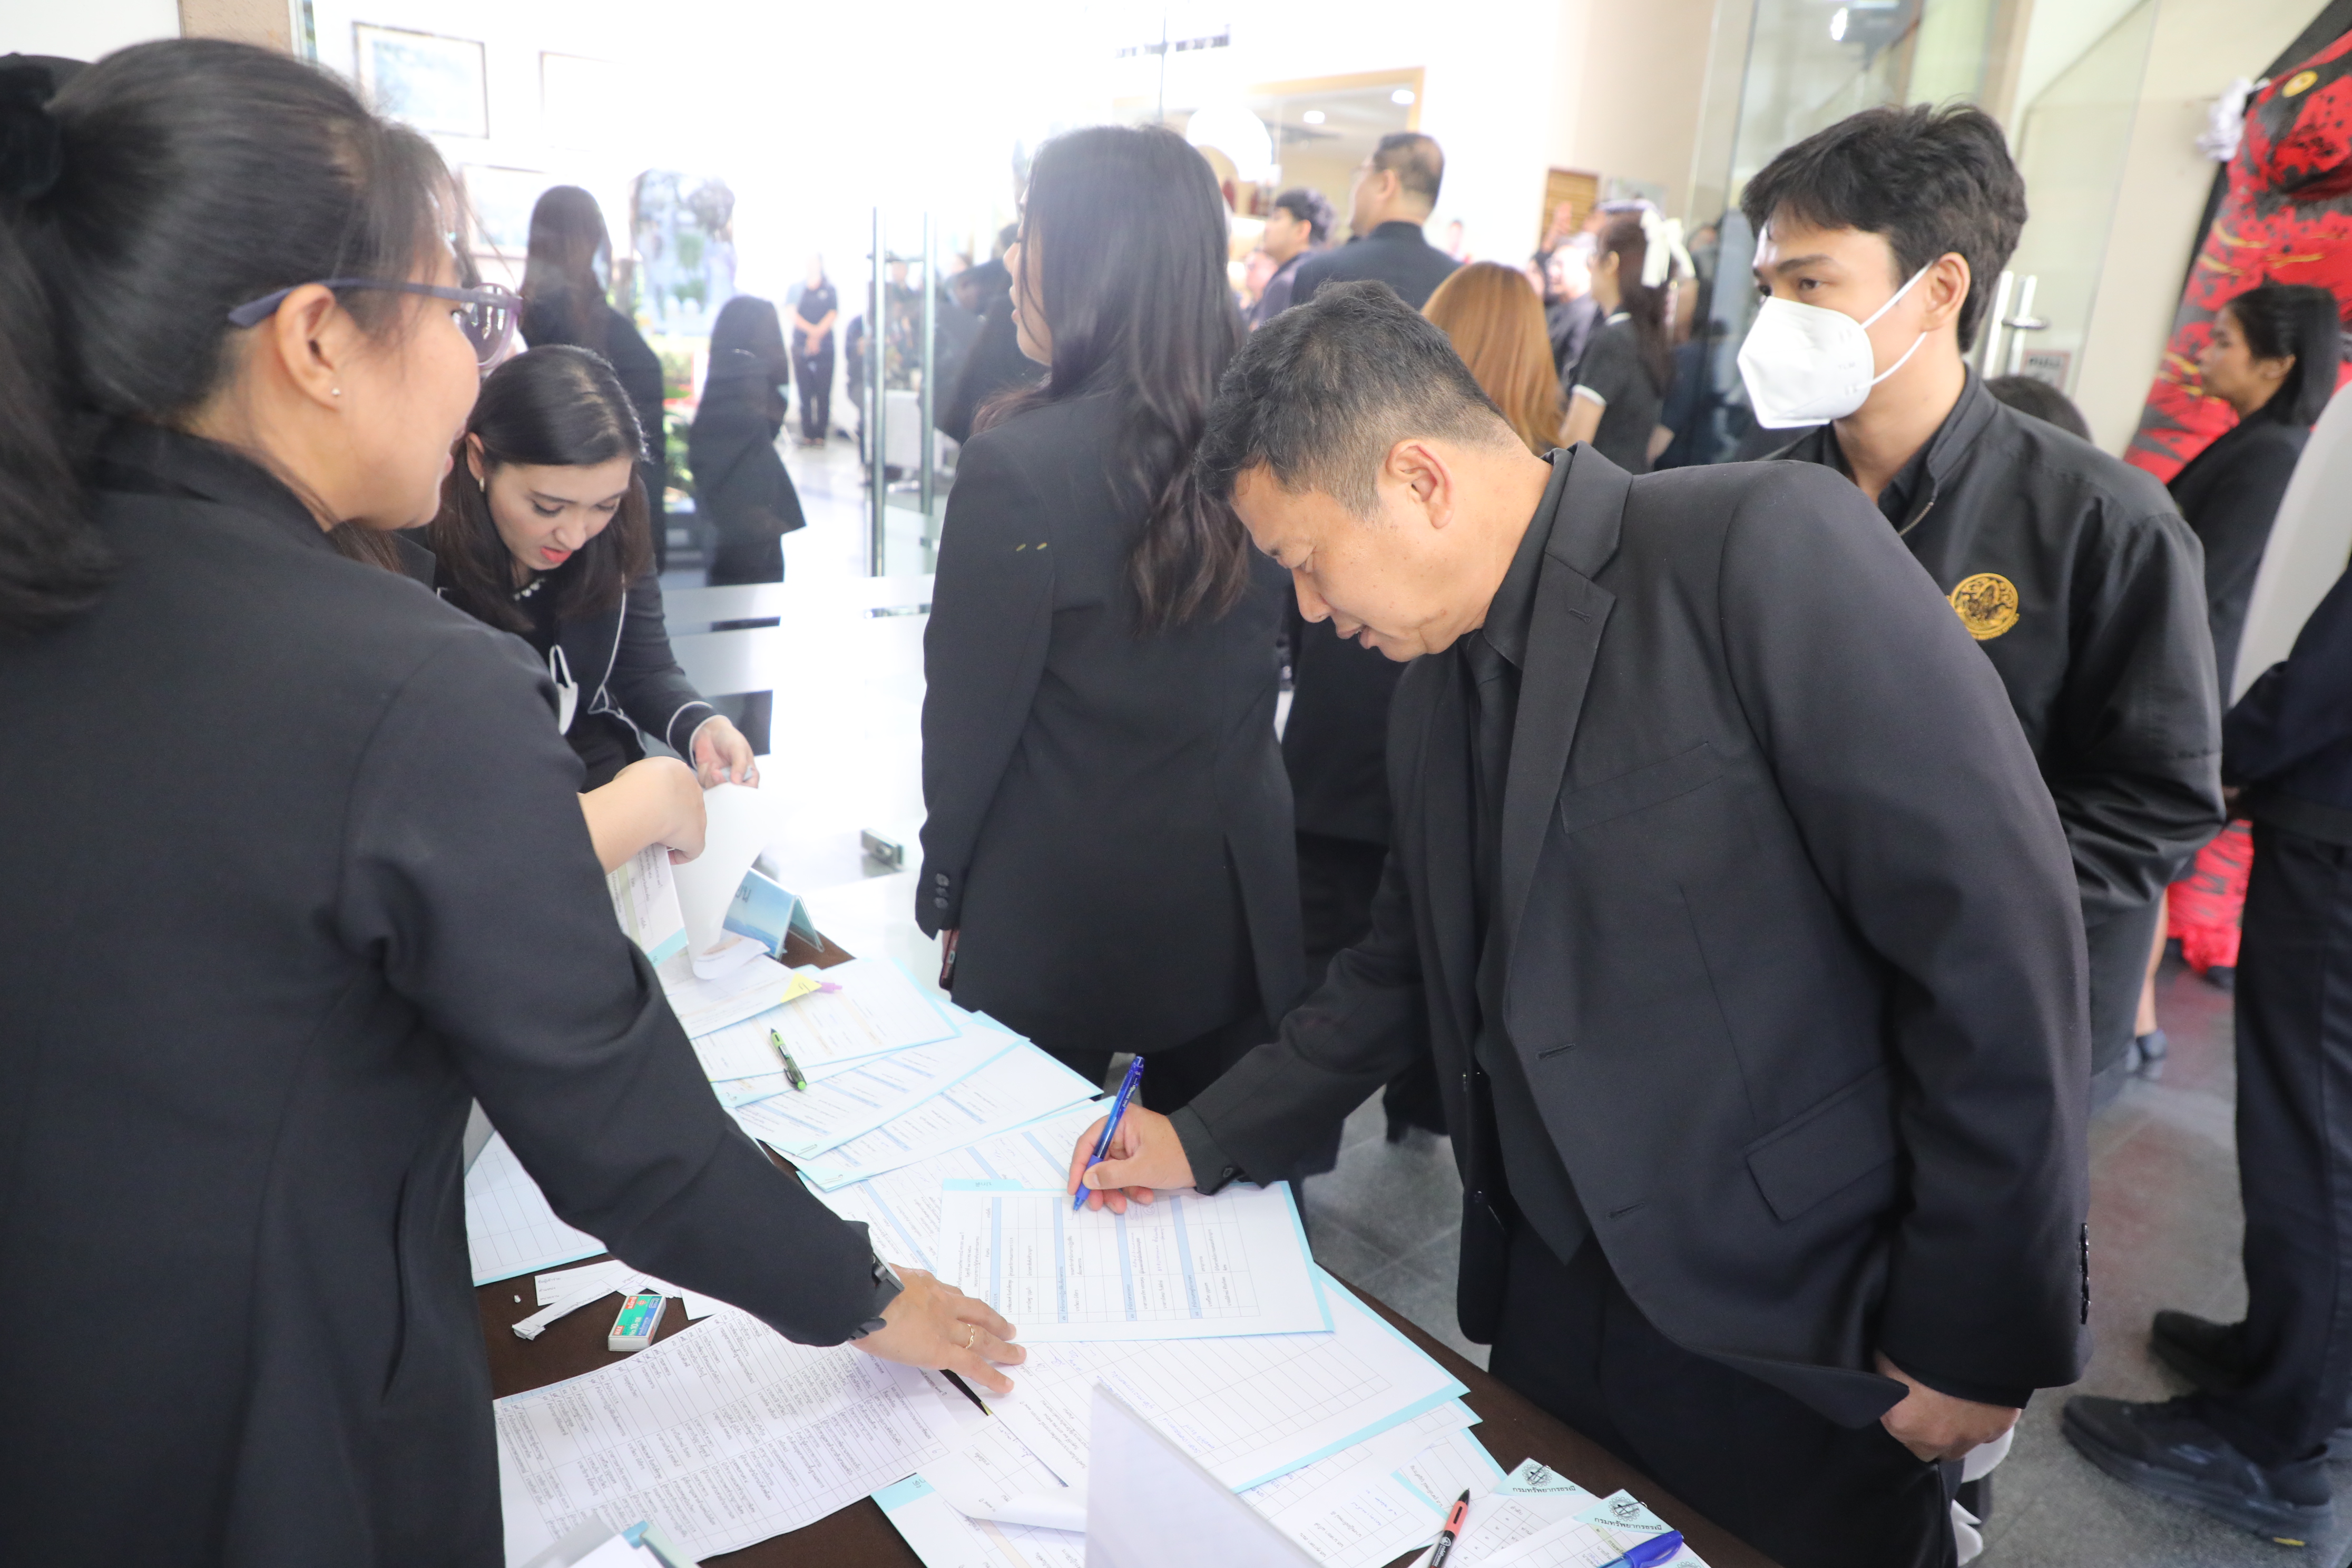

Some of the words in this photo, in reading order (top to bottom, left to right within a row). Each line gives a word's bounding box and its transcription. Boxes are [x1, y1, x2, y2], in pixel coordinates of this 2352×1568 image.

[614, 1325, 623, 1335] MAX
[728, 1322, 749, 1356] กรมพัฒนาฝีมือแรงงาน
[737, 1318, 751, 1340] กรมบัญชีกลาง
[677, 1349, 691, 1368] กรมบังคับคดี
[702, 1335, 721, 1364] กรมวิชาการเกษตร
[649, 1363, 662, 1378] กรมการข้าว
[683, 1345, 707, 1378] กรมส่งเสริมการเรียนรู้
[874, 1395, 891, 1417] เลขานุการกรม
[830, 1416, 847, 1436] เลขานุการกรม
[804, 1428, 821, 1448] เลขานุการกรม
[759, 1447, 775, 1468] เลขานุการกรม
[1594, 1517, 1662, 1530] กรมทรัพยากรธรณี
